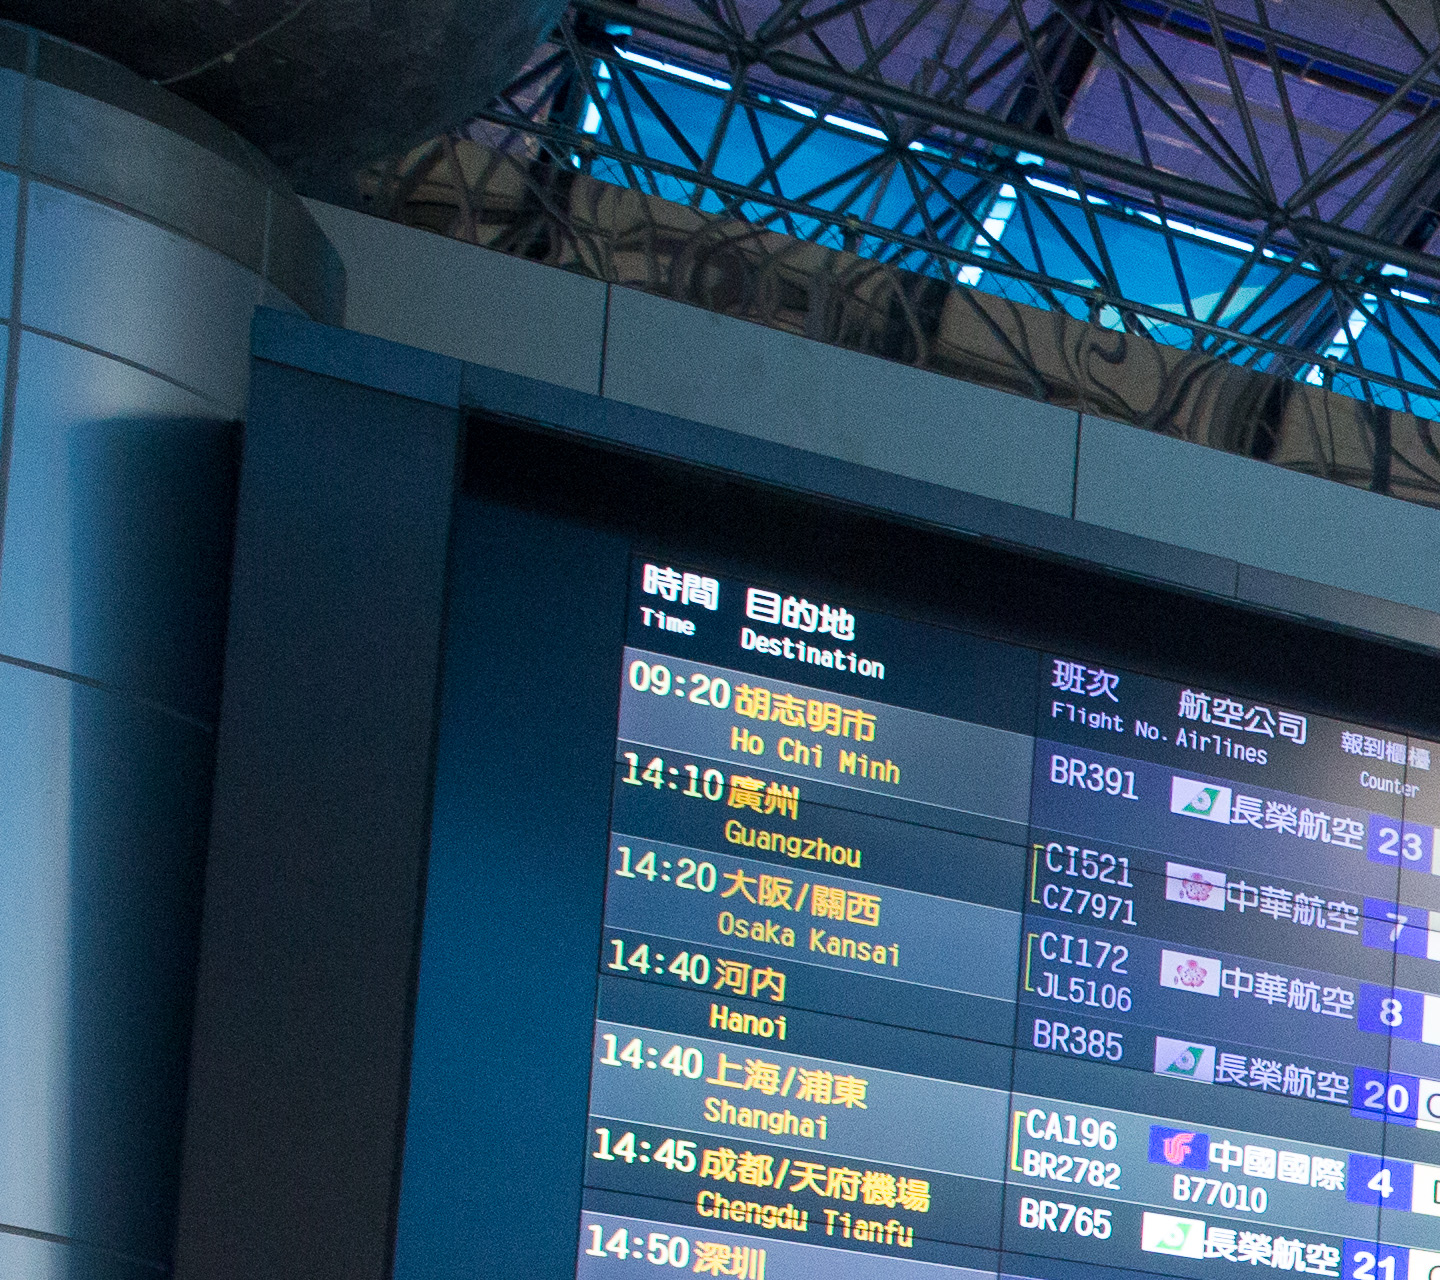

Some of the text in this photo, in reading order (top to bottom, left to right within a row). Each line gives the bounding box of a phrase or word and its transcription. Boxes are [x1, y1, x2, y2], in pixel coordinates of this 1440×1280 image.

[642, 564, 855, 641] 時間 目的地
[641, 606, 885, 680] Time Destination
[629, 660, 877, 743] 09:20 胡志明市
[1052, 659, 1308, 744] 班次 航空公司
[1052, 701, 1268, 766] Flight No. Airlines
[622, 752, 799, 820] 14:10 廣州
[730, 726, 900, 785] Ho Chi Minh
[1051, 755, 1140, 800] BR391
[1231, 797, 1364, 850] 長榮航空
[1378, 827, 1423, 861] 23
[724, 820, 861, 870] Guangzhou
[615, 846, 880, 928] 14:20 大阪/關西
[608, 939, 710, 986] 14:40
[718, 912, 900, 968] Osaka Kansai
[710, 1003, 788, 1041] Hanoi
[1032, 1019, 1124, 1061] BR385
[599, 1033, 868, 1111] 14:40 上海/浦東
[704, 1097, 828, 1141] Shanghai
[1026, 1108, 1345, 1193] CA196 中國國際
[592, 1128, 931, 1213] 14:45 成都/天府機場
[586, 1224, 689, 1269] 14:50
[697, 1191, 914, 1249] Chengdu Tianfu
[1019, 1199, 1112, 1240] BR765
